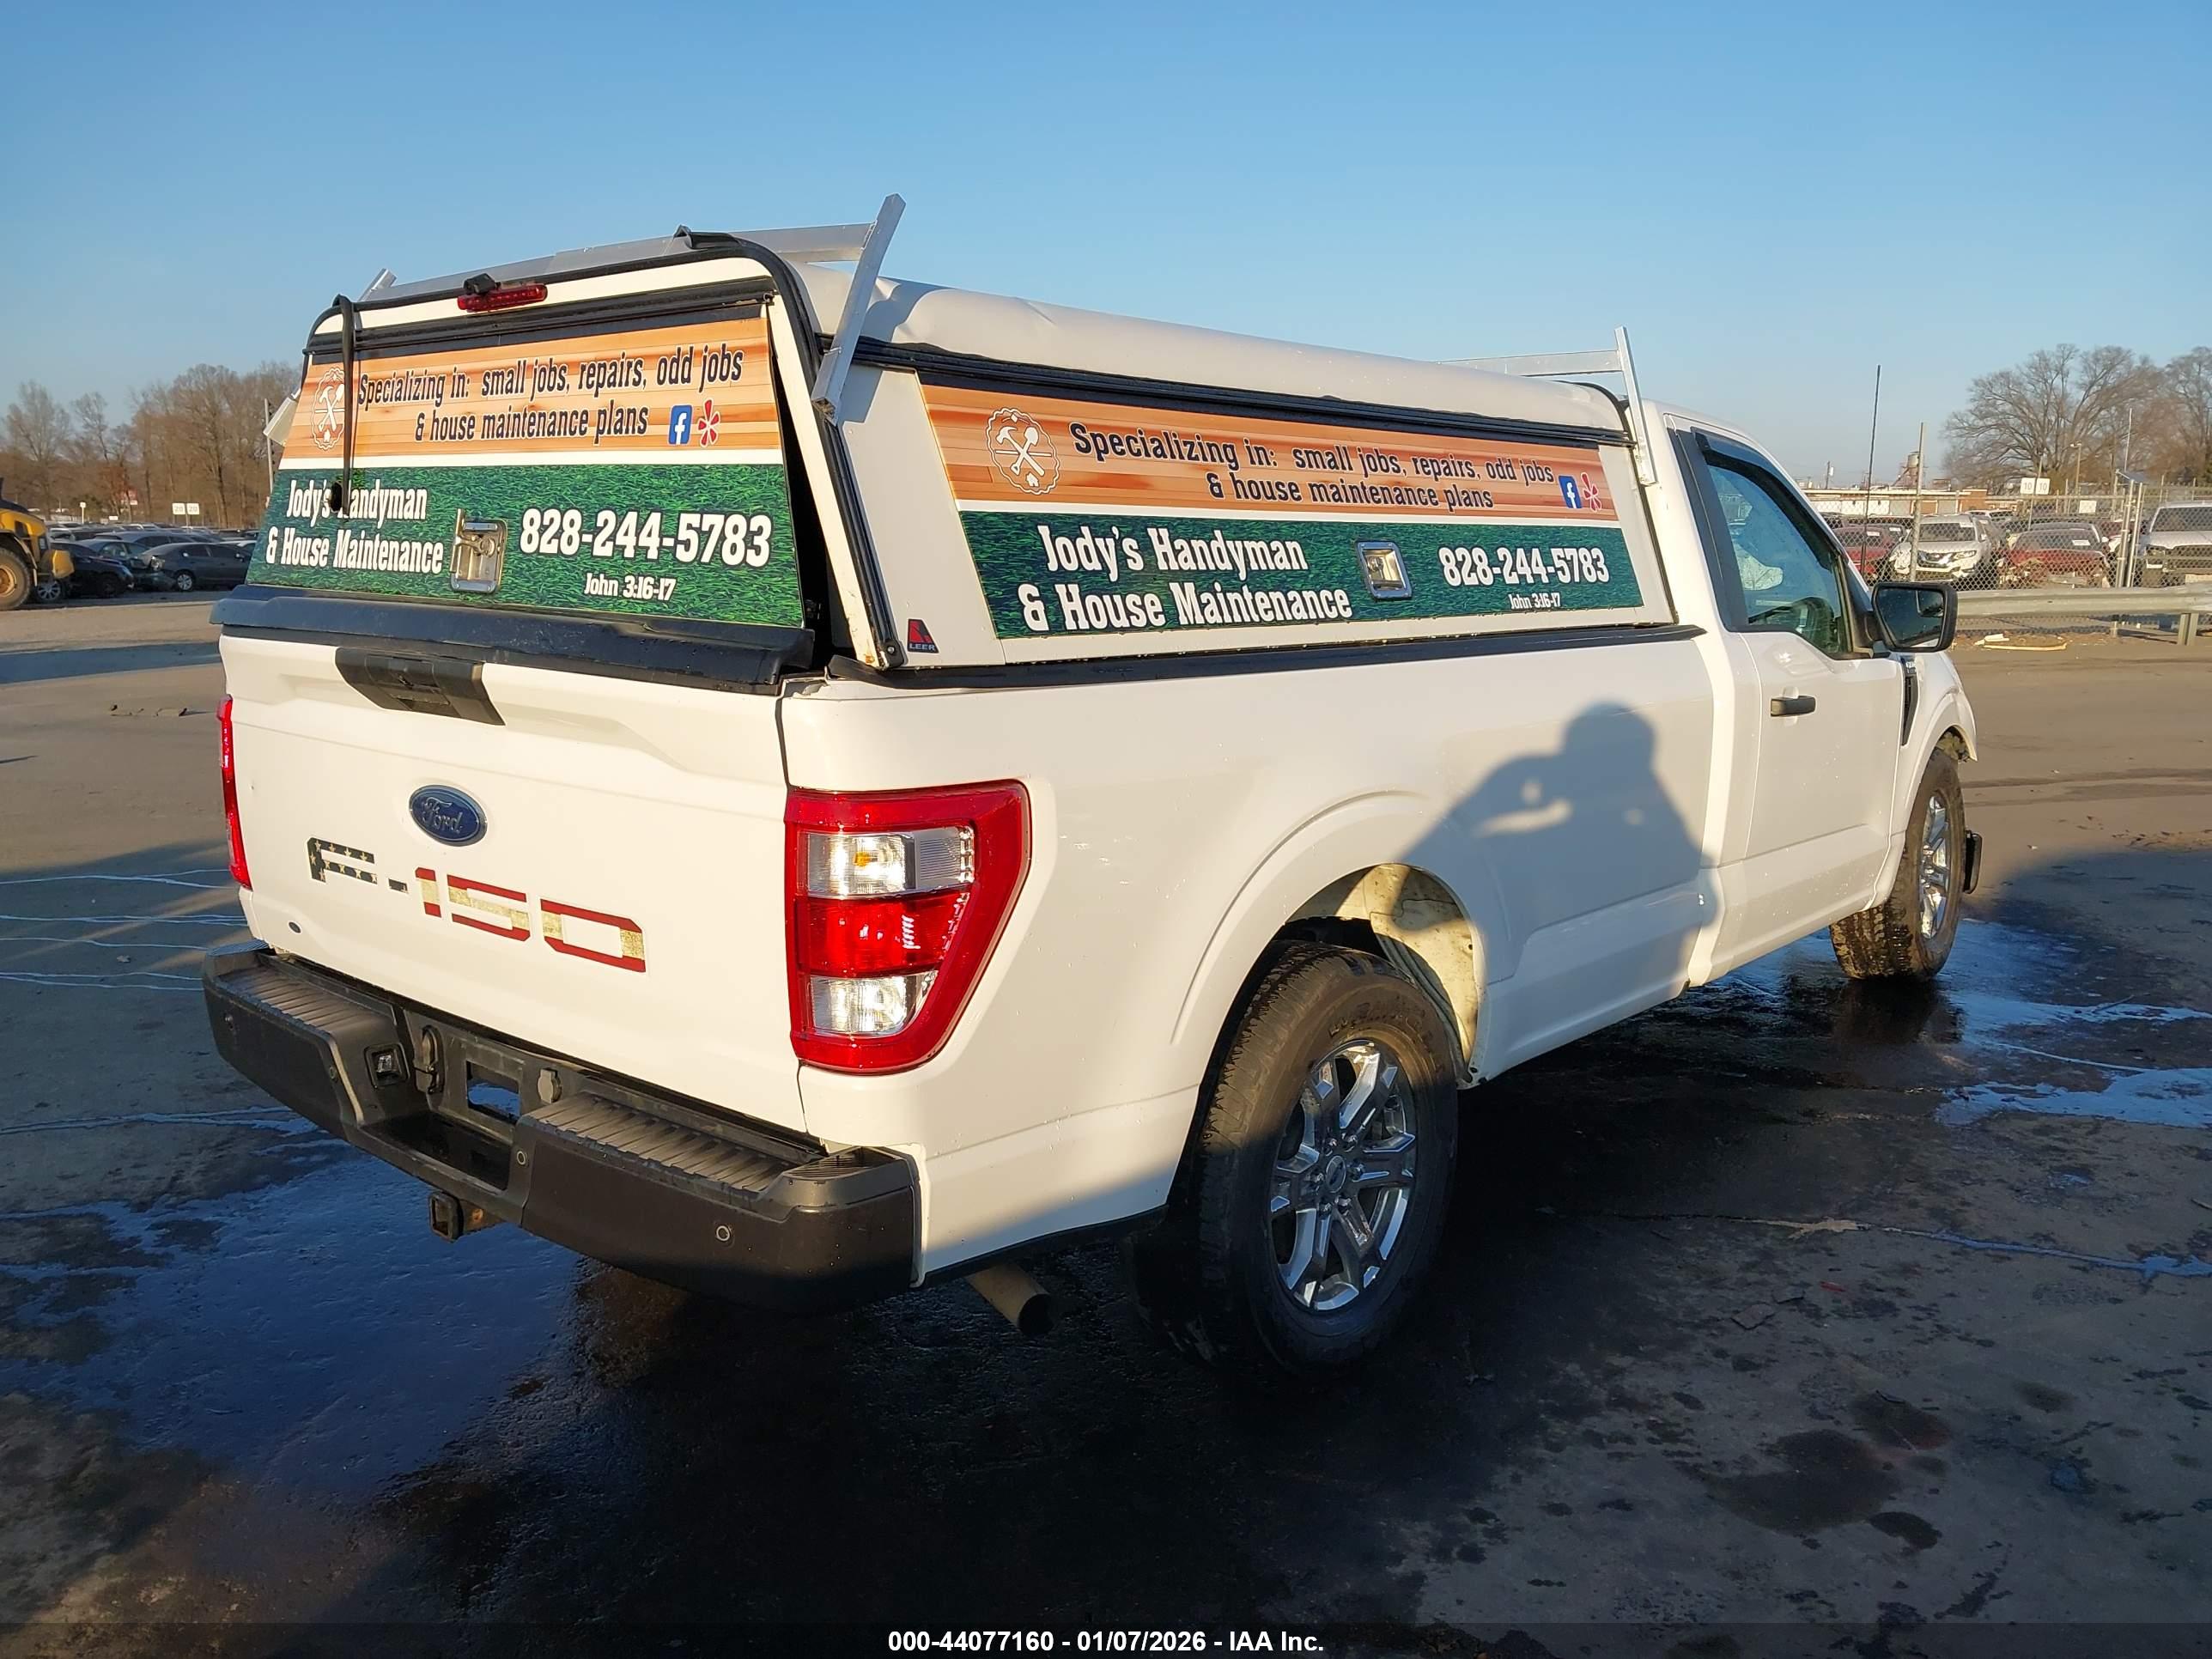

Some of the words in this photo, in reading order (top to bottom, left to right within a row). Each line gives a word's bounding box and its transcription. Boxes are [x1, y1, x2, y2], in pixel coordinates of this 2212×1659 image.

[357, 369, 446, 411] Specializing
[450, 367, 470, 398] in:
[482, 359, 527, 397] small
[530, 357, 570, 402] jobs,
[578, 351, 647, 398] repairs,
[657, 346, 694, 386] odd
[699, 343, 744, 393] jobs
[415, 412, 425, 441] &
[429, 410, 476, 441] house
[480, 404, 589, 440] maintenance
[593, 399, 648, 445] plans
[1069, 422, 1241, 471] Specializing
[1243, 438, 1278, 467] in:
[1291, 445, 1353, 471] small
[1357, 448, 1407, 479] jobs,
[1412, 454, 1481, 483] repairs,
[1486, 458, 1517, 481] odd
[1520, 459, 1554, 487] jobs
[286, 479, 331, 527] Jody's
[1206, 472, 1224, 499] &
[1229, 471, 1302, 502] house
[1308, 478, 1439, 507] maintenance
[1443, 483, 1493, 513] plans
[265, 526, 278, 564] &
[281, 527, 330, 568] House
[332, 529, 444, 574] Maintenance
[520, 507, 772, 568] 828-244-5783
[1036, 525, 1145, 582] Jody's
[1146, 527, 1310, 581] Handyman
[584, 572, 618, 596] John
[623, 575, 677, 601] 3:16-17
[1438, 546, 1610, 587] 828-244-5783
[1018, 583, 1049, 631] &
[1054, 583, 1166, 630] House
[1169, 581, 1352, 626] Maintenance
[1508, 593, 1533, 610] John
[1532, 592, 1561, 609] 3:16-17
[908, 642, 936, 651] LEER
[420, 796, 464, 835] Ford
[306, 836, 647, 973] F-150
